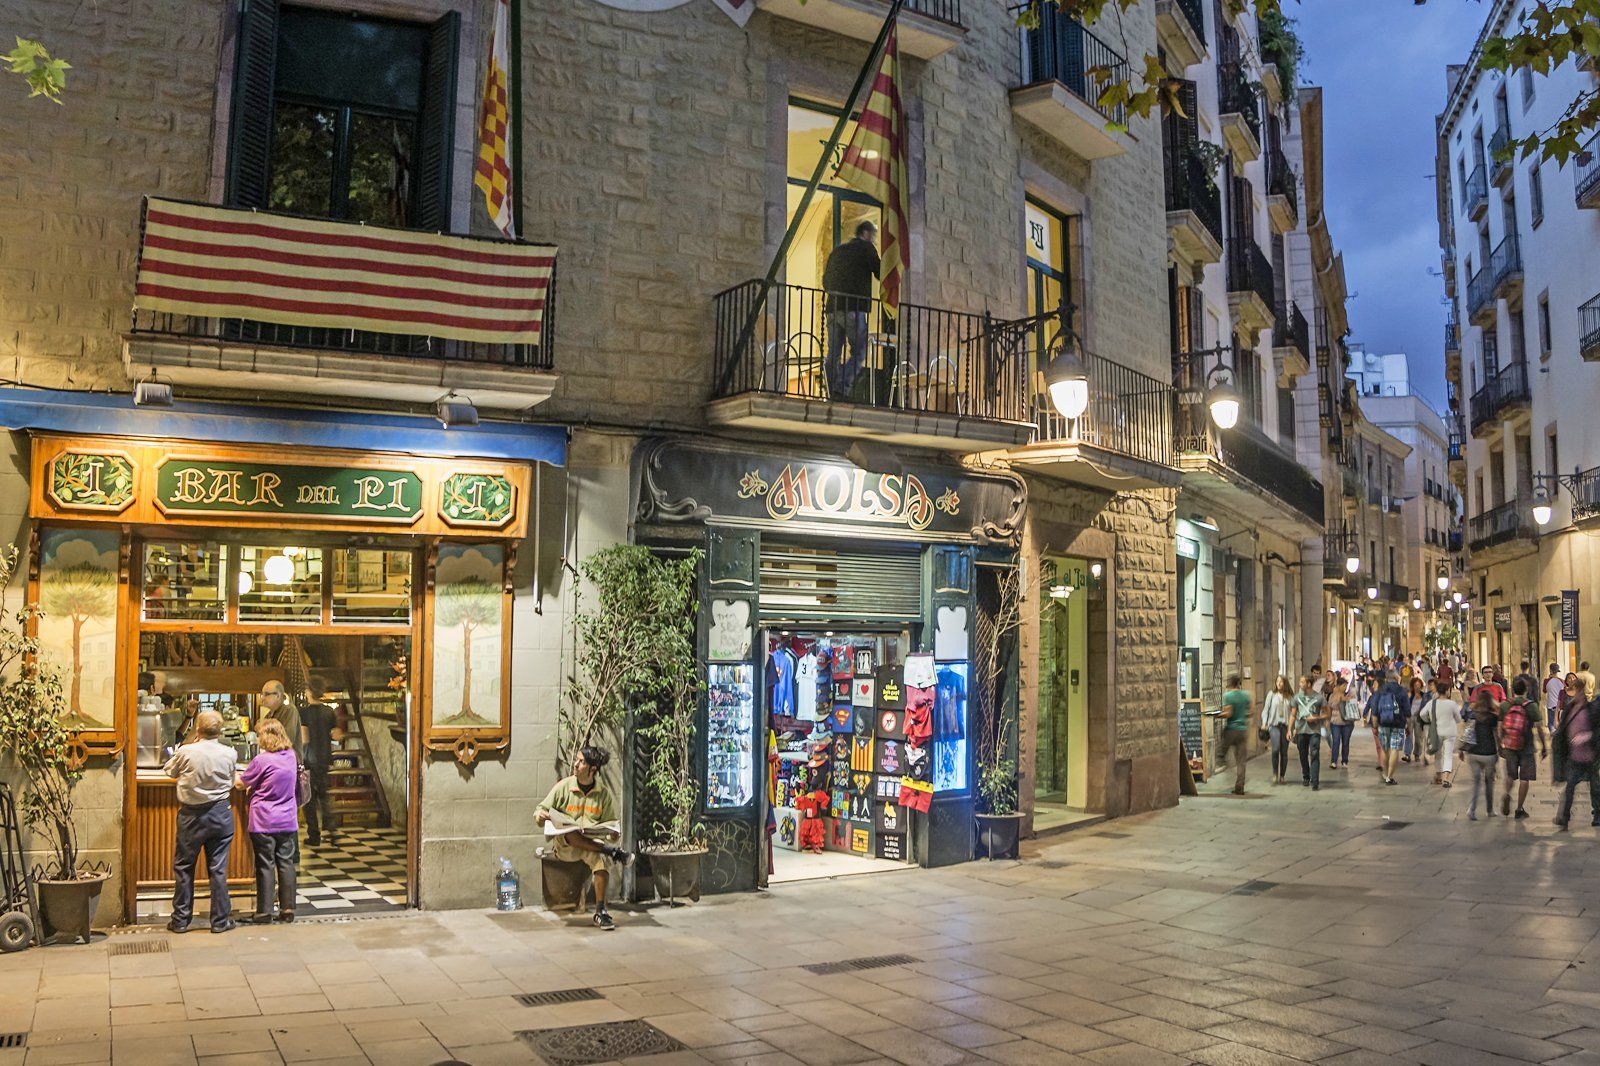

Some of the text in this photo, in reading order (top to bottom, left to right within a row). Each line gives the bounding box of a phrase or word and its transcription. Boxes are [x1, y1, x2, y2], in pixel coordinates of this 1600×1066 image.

[169, 467, 411, 512] BAR DEL PI
[765, 463, 935, 531] MOLSA
